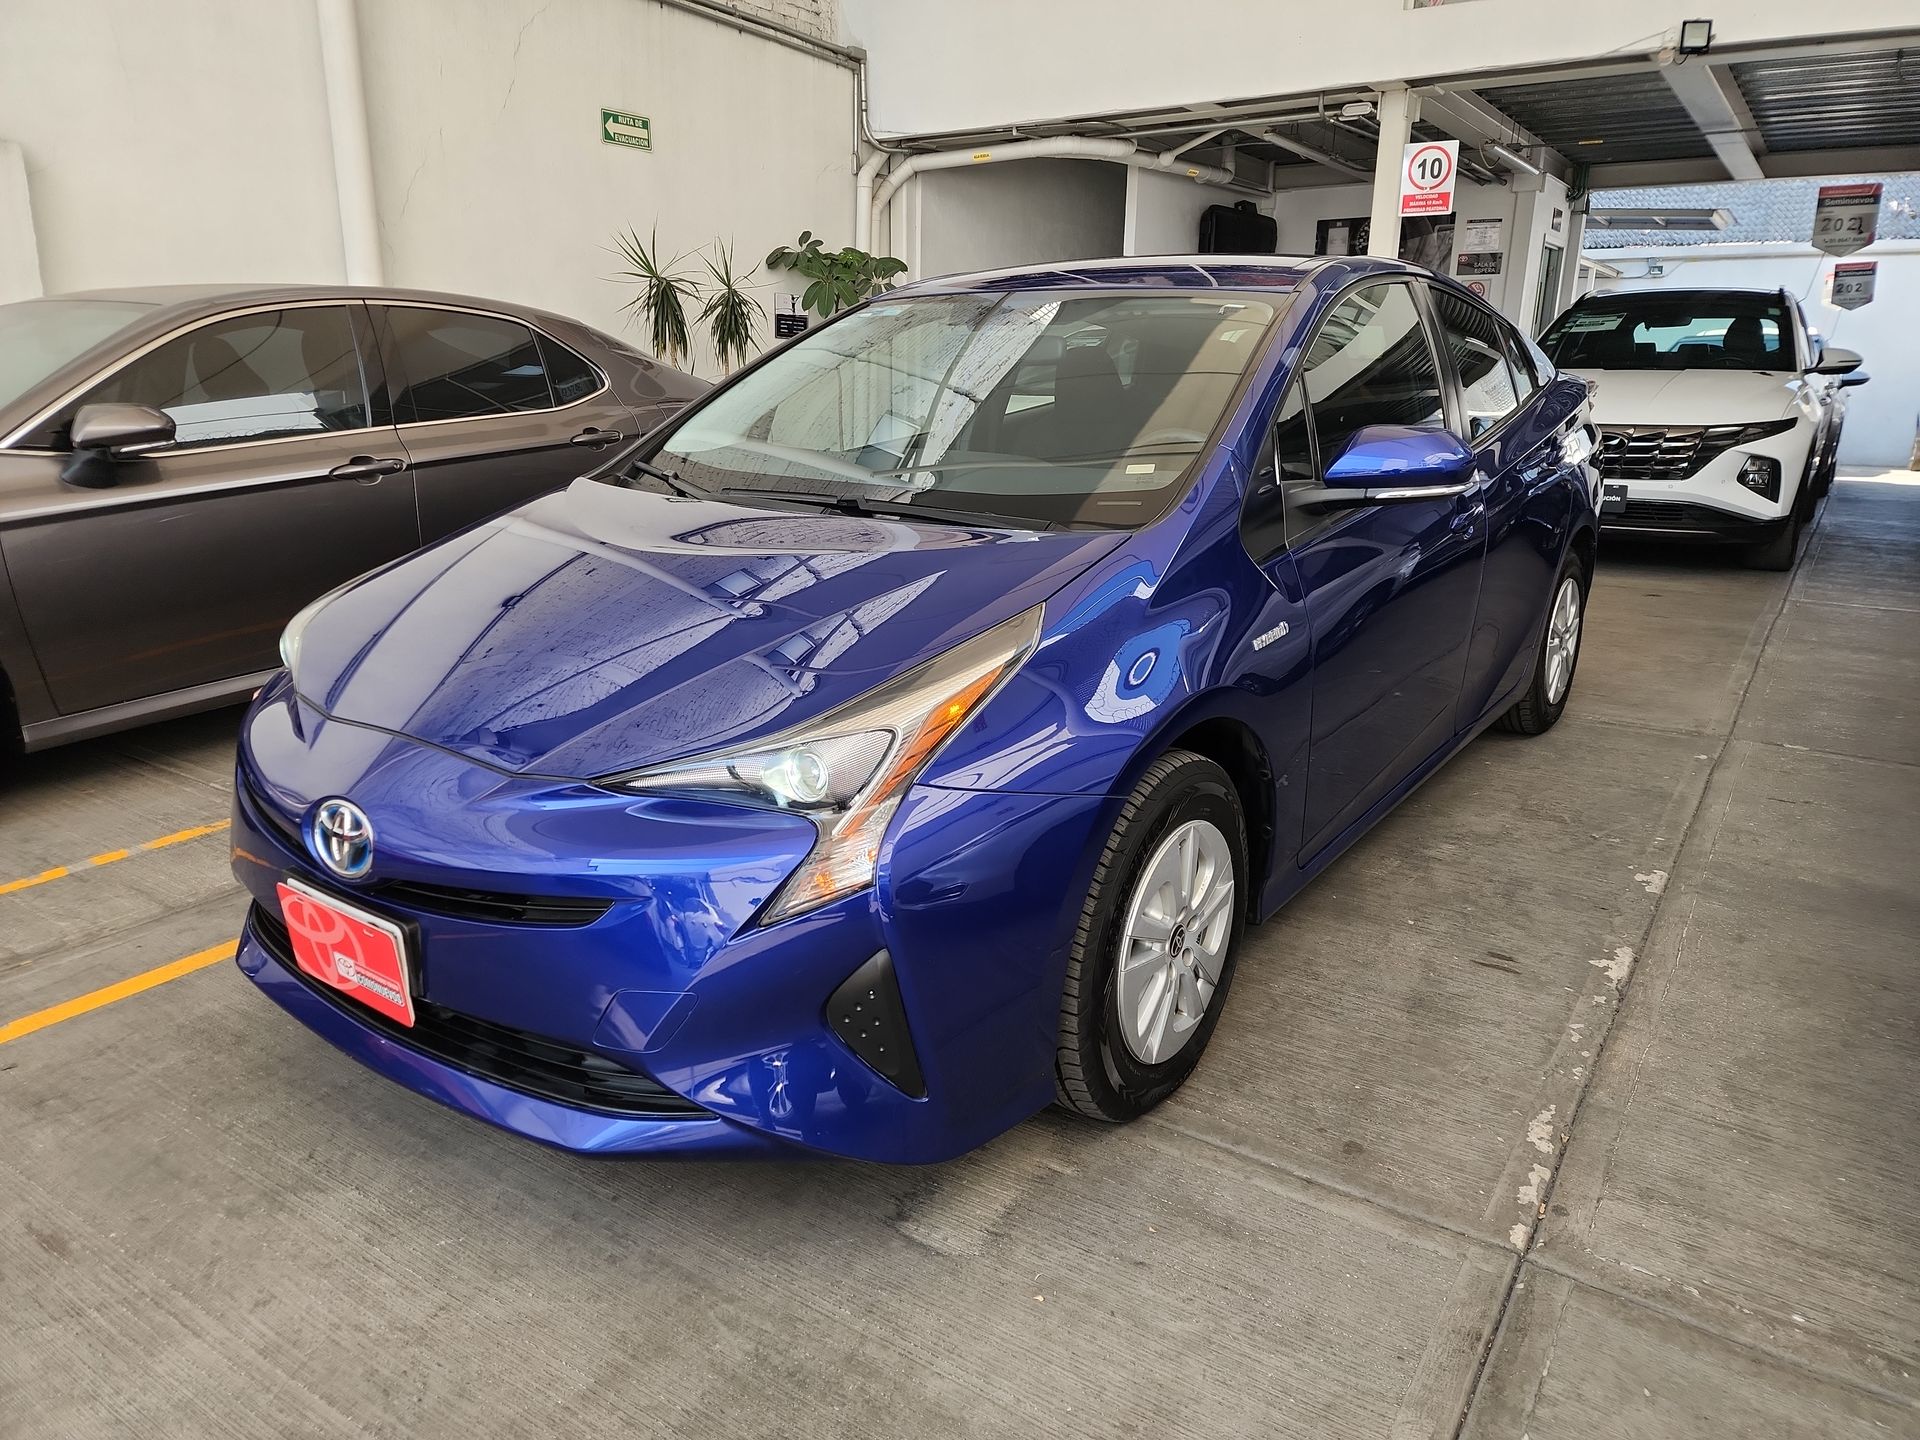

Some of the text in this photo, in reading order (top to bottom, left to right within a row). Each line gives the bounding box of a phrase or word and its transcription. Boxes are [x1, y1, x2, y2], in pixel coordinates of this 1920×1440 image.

[618, 115, 643, 128] RUTA DE
[1417, 157, 1443, 180] 10
[1825, 196, 1875, 206] Seminuevos
